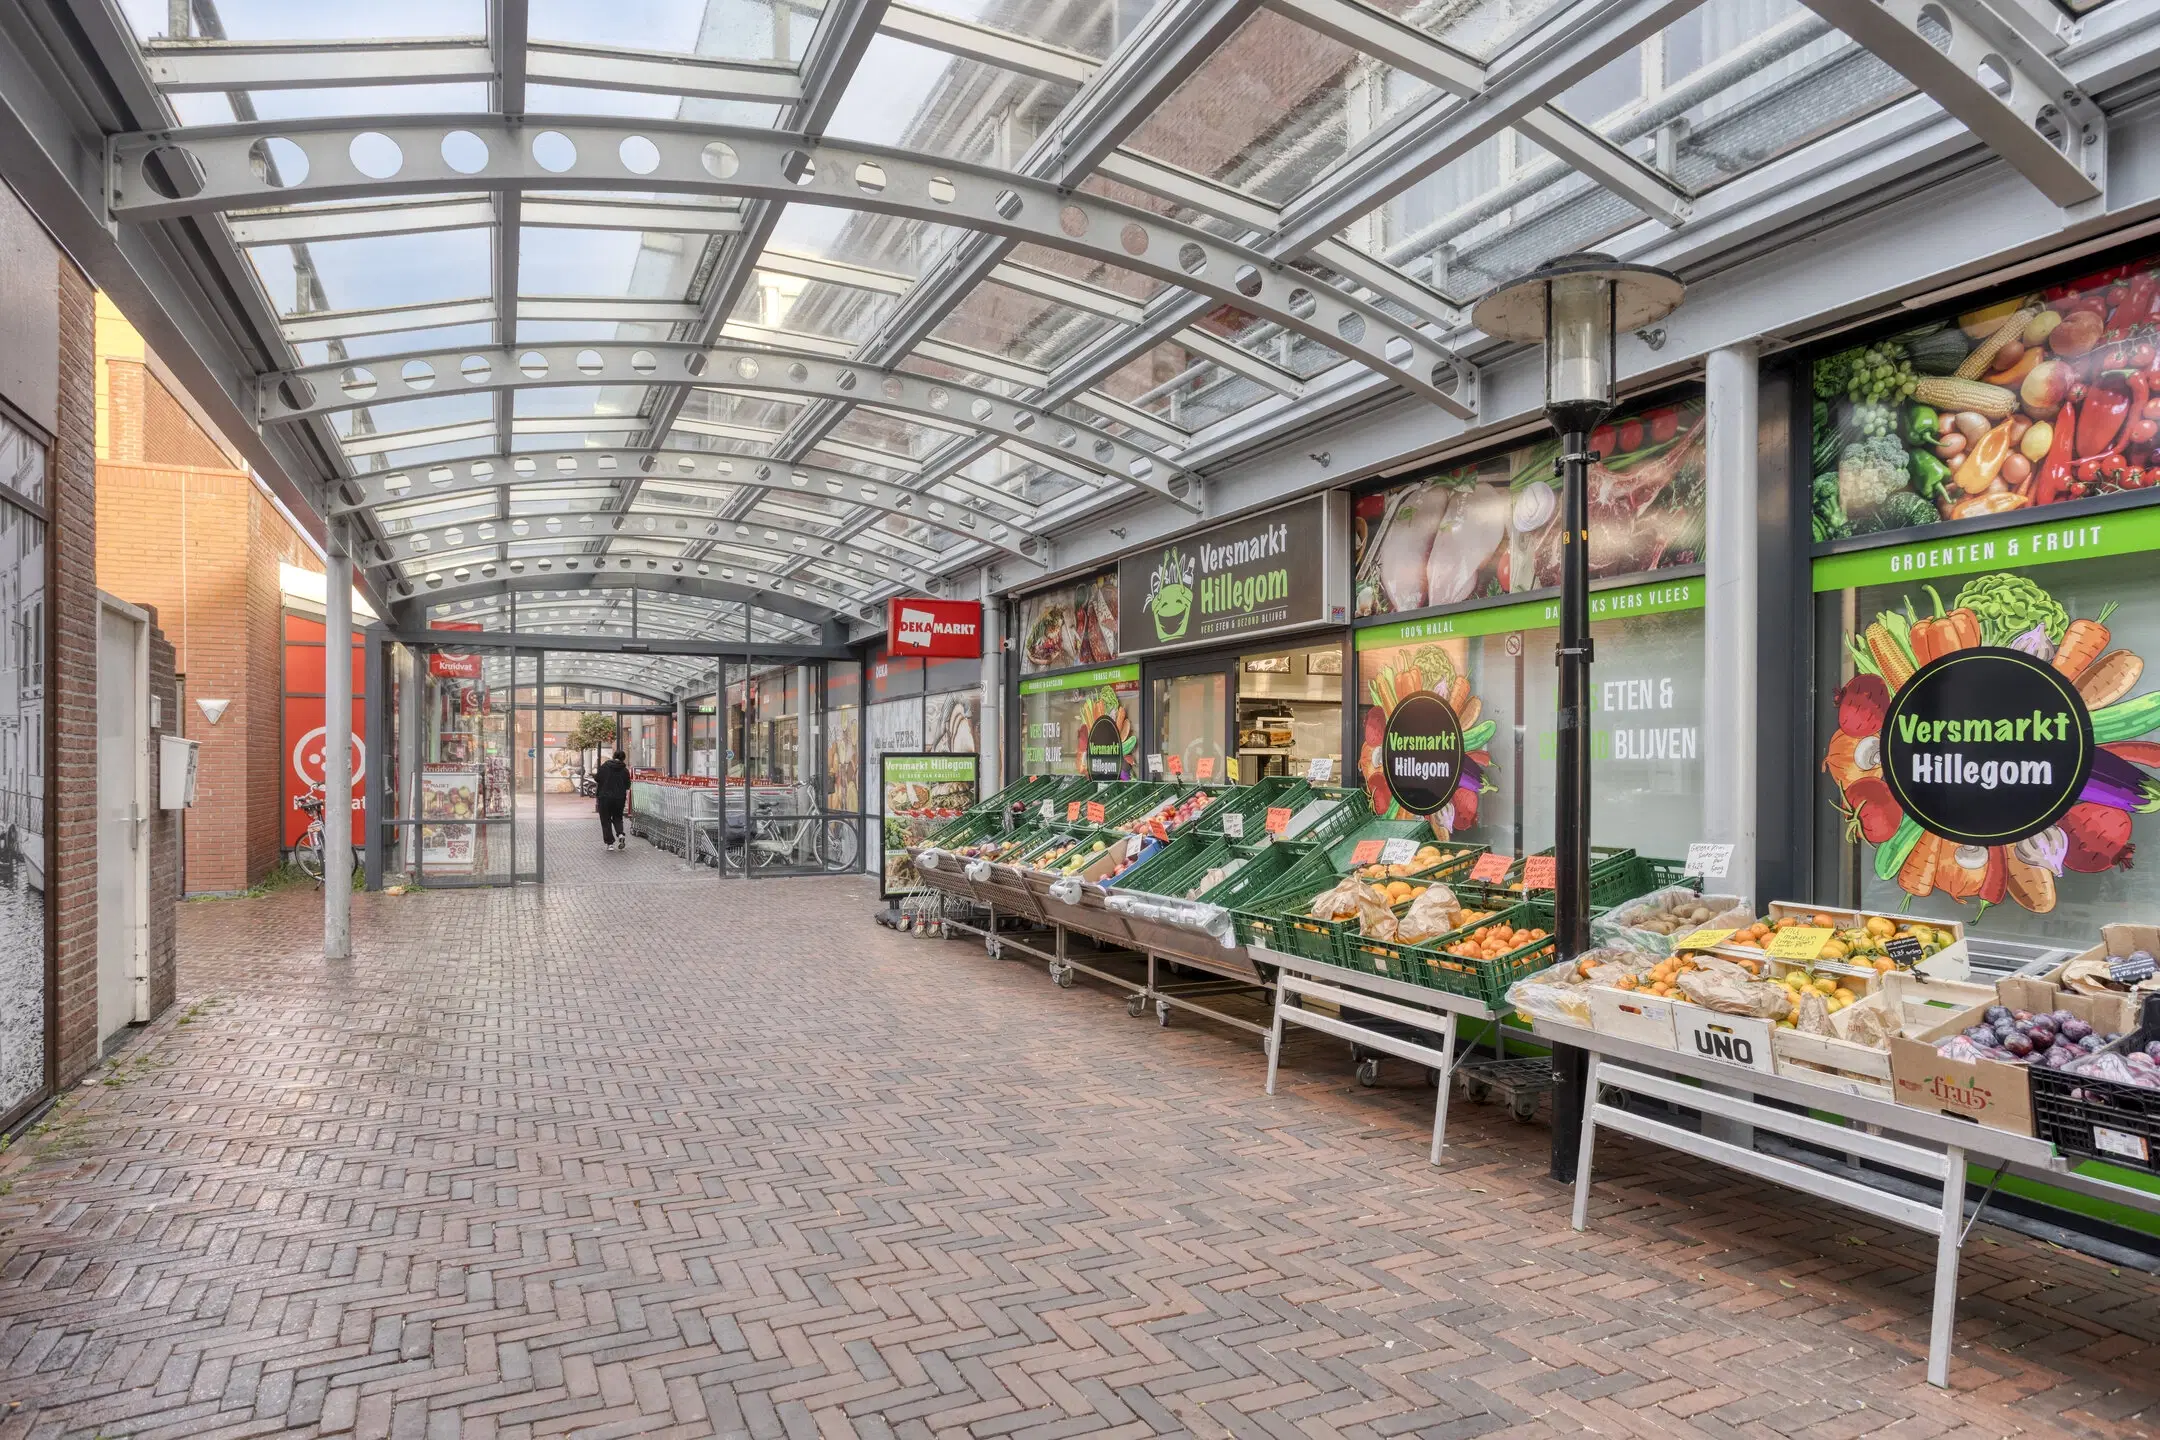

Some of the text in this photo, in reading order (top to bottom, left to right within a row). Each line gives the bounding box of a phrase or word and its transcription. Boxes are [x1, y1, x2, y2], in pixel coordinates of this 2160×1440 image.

[1200, 524, 1288, 574] Versmarkt
[1890, 526, 2102, 573] GROENTEN & FRUIT
[1201, 568, 1288, 614] Hillegom
[1613, 593, 1642, 610] VERS
[1650, 586, 1690, 604] VLEES
[900, 622, 976, 635] DEKAMARKT
[1201, 624, 1214, 634] VERS
[1216, 620, 1230, 632] ETEN
[1237, 616, 1260, 628] GEZOND
[1262, 610, 1288, 624] BLIJVEN
[1400, 620, 1454, 639] 100% HALAL
[440, 662, 472, 672] Kruidvat
[876, 664, 888, 678] DEKA
[1604, 679, 1652, 711] ETEN
[1660, 678, 1673, 709] &
[1898, 710, 2070, 744] Versmarkt
[1089, 742, 1119, 755] Versmarkt
[1390, 730, 1456, 751] Versmarkt
[1615, 728, 1696, 760] BLIJVEN
[886, 759, 972, 771] Versmarkt Hillegom
[1092, 759, 1117, 774] Hillegom
[1394, 757, 1449, 780] Hillegom
[1912, 753, 2052, 790] Hillegom
[1694, 1029, 1754, 1064] UNO
